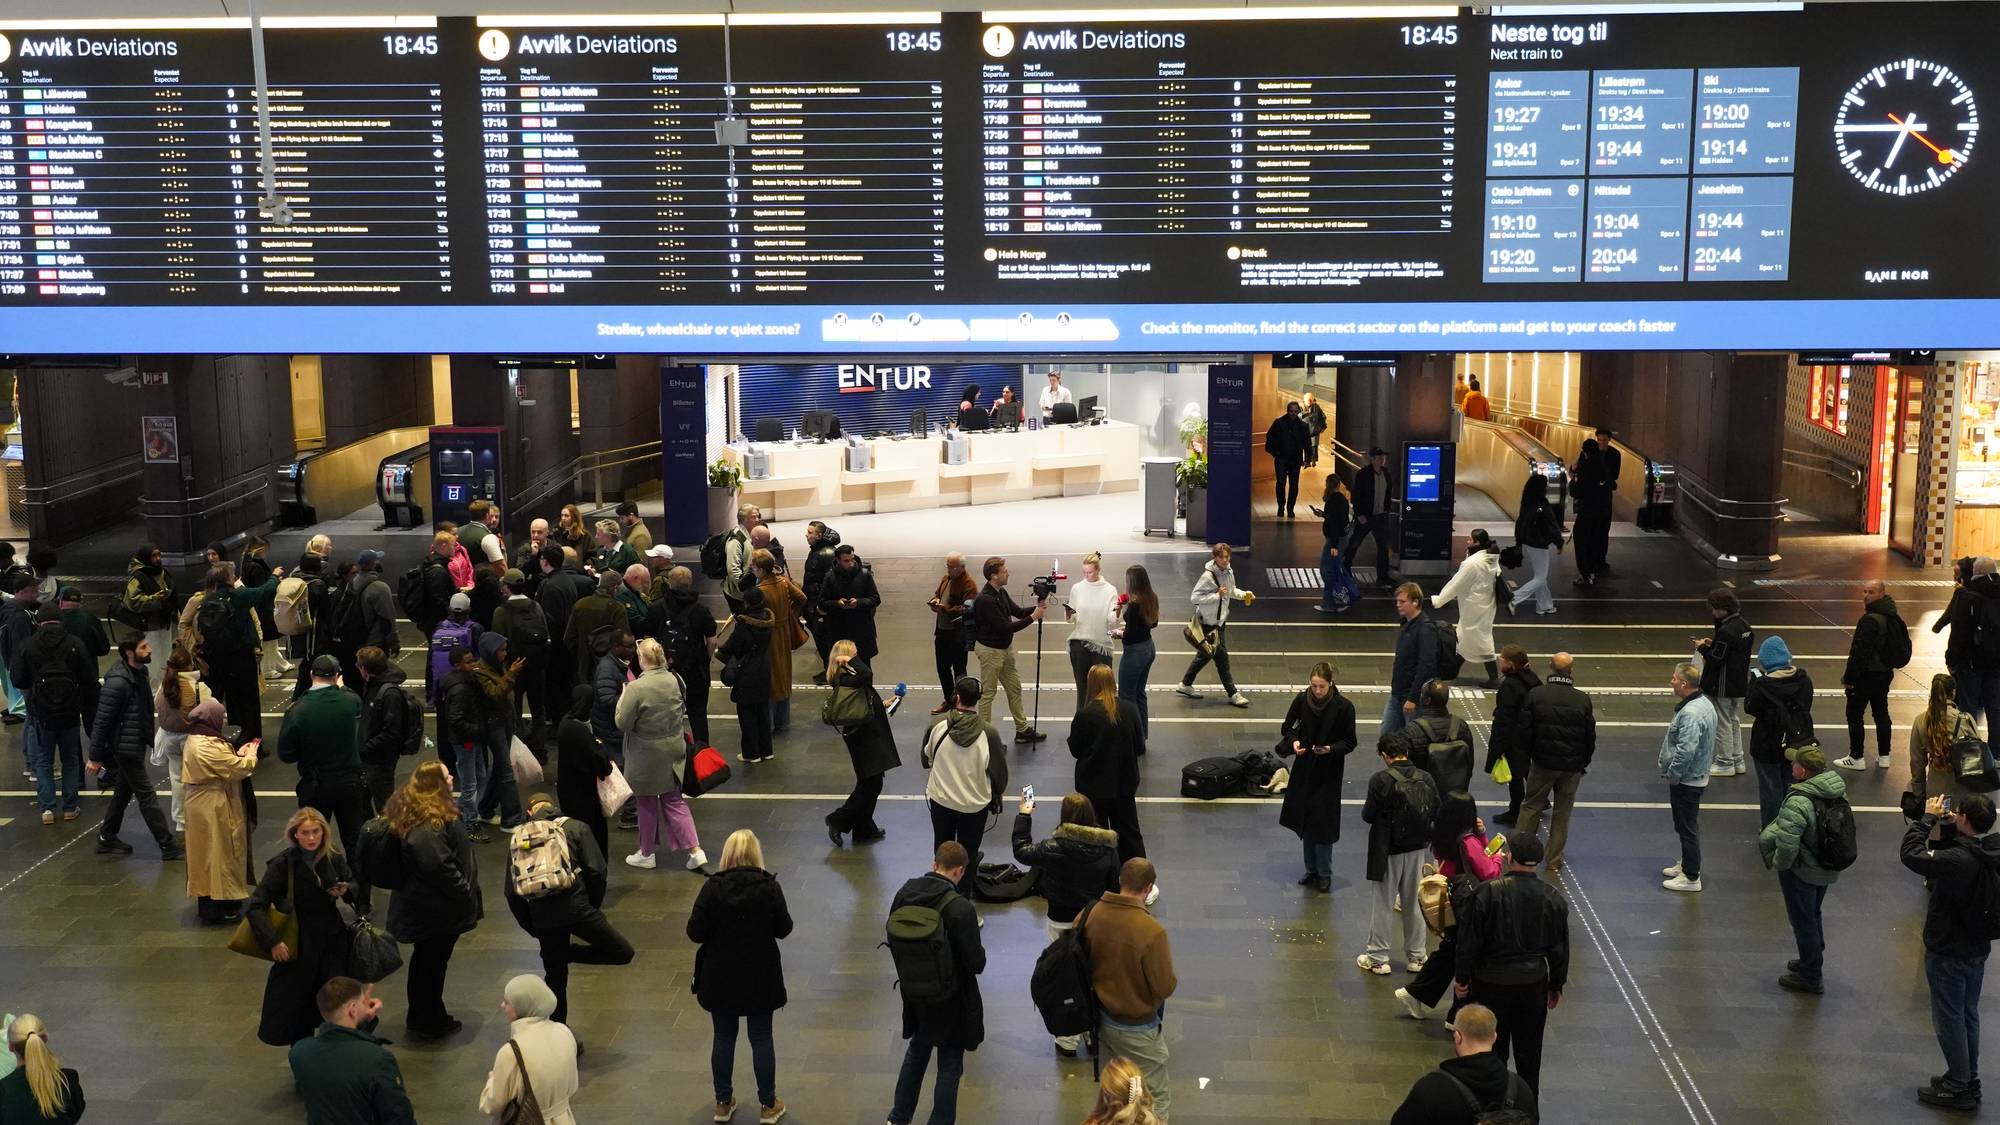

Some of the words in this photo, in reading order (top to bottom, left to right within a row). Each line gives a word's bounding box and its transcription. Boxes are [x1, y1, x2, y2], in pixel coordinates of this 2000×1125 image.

[1023, 30, 1077, 49] Avvik
[1083, 30, 1185, 49] Deviations
[1401, 26, 1457, 45] 18:45
[1492, 24, 1547, 42] Neste
[1552, 25, 1584, 45] tog
[1588, 22, 1606, 40] til
[20, 37, 73, 56] Avvik
[78, 38, 177, 56] Deviations
[384, 36, 438, 54] 18:45
[519, 34, 572, 53] Avvik
[577, 35, 676, 53] Deviations
[887, 32, 941, 51] 18:45
[1491, 49, 1517, 60] Next
[1521, 48, 1547, 59] train
[1551, 49, 1562, 59] to
[1495, 78, 1522, 88] Asker
[1600, 77, 1645, 86] Lillestrøm
[1704, 76, 1718, 85] Ski
[1495, 107, 1540, 122] 19:27
[1599, 106, 1644, 121] 19:34
[1704, 104, 1749, 120] 19:00
[483, 118, 507, 127] 17:14
[484, 149, 508, 157] 17:17
[1494, 143, 1536, 158] 19:41
[1598, 141, 1642, 156] 19:44
[1702, 140, 1747, 155] 19:14
[984, 177, 1008, 185] 18:02
[1044, 176, 1091, 185] Trondheim
[1092, 176, 1099, 185] S
[1492, 187, 1513, 196] Oslo
[1514, 186, 1552, 196] lufthavn
[1595, 186, 1631, 195] Nittedal
[1698, 184, 1743, 194] Jessheim
[984, 192, 1009, 201] 18:04
[1492, 215, 1536, 230] 19:10
[1595, 214, 1639, 229] 19:04
[1698, 213, 1743, 228] 19:44
[999, 250, 1018, 258] Hele
[1020, 250, 1046, 260] Norge
[1242, 249, 1267, 257] Streik
[1491, 250, 1535, 264] 19:20
[1592, 249, 1637, 264] 20:04
[1696, 248, 1741, 265] 20:44
[1865, 271, 1897, 282] BANE
[1902, 271, 1928, 280] NOR
[491, 284, 515, 292] 17:44
[598, 323, 644, 336] Stroller,
[646, 323, 713, 335] wheelchair
[714, 326, 728, 335] or
[730, 324, 763, 337] quiet
[765, 323, 800, 335] zone?
[1141, 322, 1179, 334] Check
[1181, 322, 1203, 334] the
[1205, 322, 1257, 335] monitor,
[1260, 321, 1286, 333] find
[1287, 322, 1309, 333] the
[1311, 323, 1356, 333] correct
[1358, 322, 1397, 333] sector
[1399, 324, 1416, 333] on
[1418, 321, 1440, 332] the
[1442, 320, 1498, 335] platform
[1499, 320, 1525, 332] and
[1526, 322, 1549, 335] get
[1551, 322, 1565, 332] to
[1567, 323, 1597, 335] your
[1599, 320, 1636, 332] coach
[1638, 319, 1676, 332] faster
[670, 380, 696, 388] ENTUR
[838, 365, 931, 392] ENTUR
[1217, 378, 1243, 386] ENTUR
